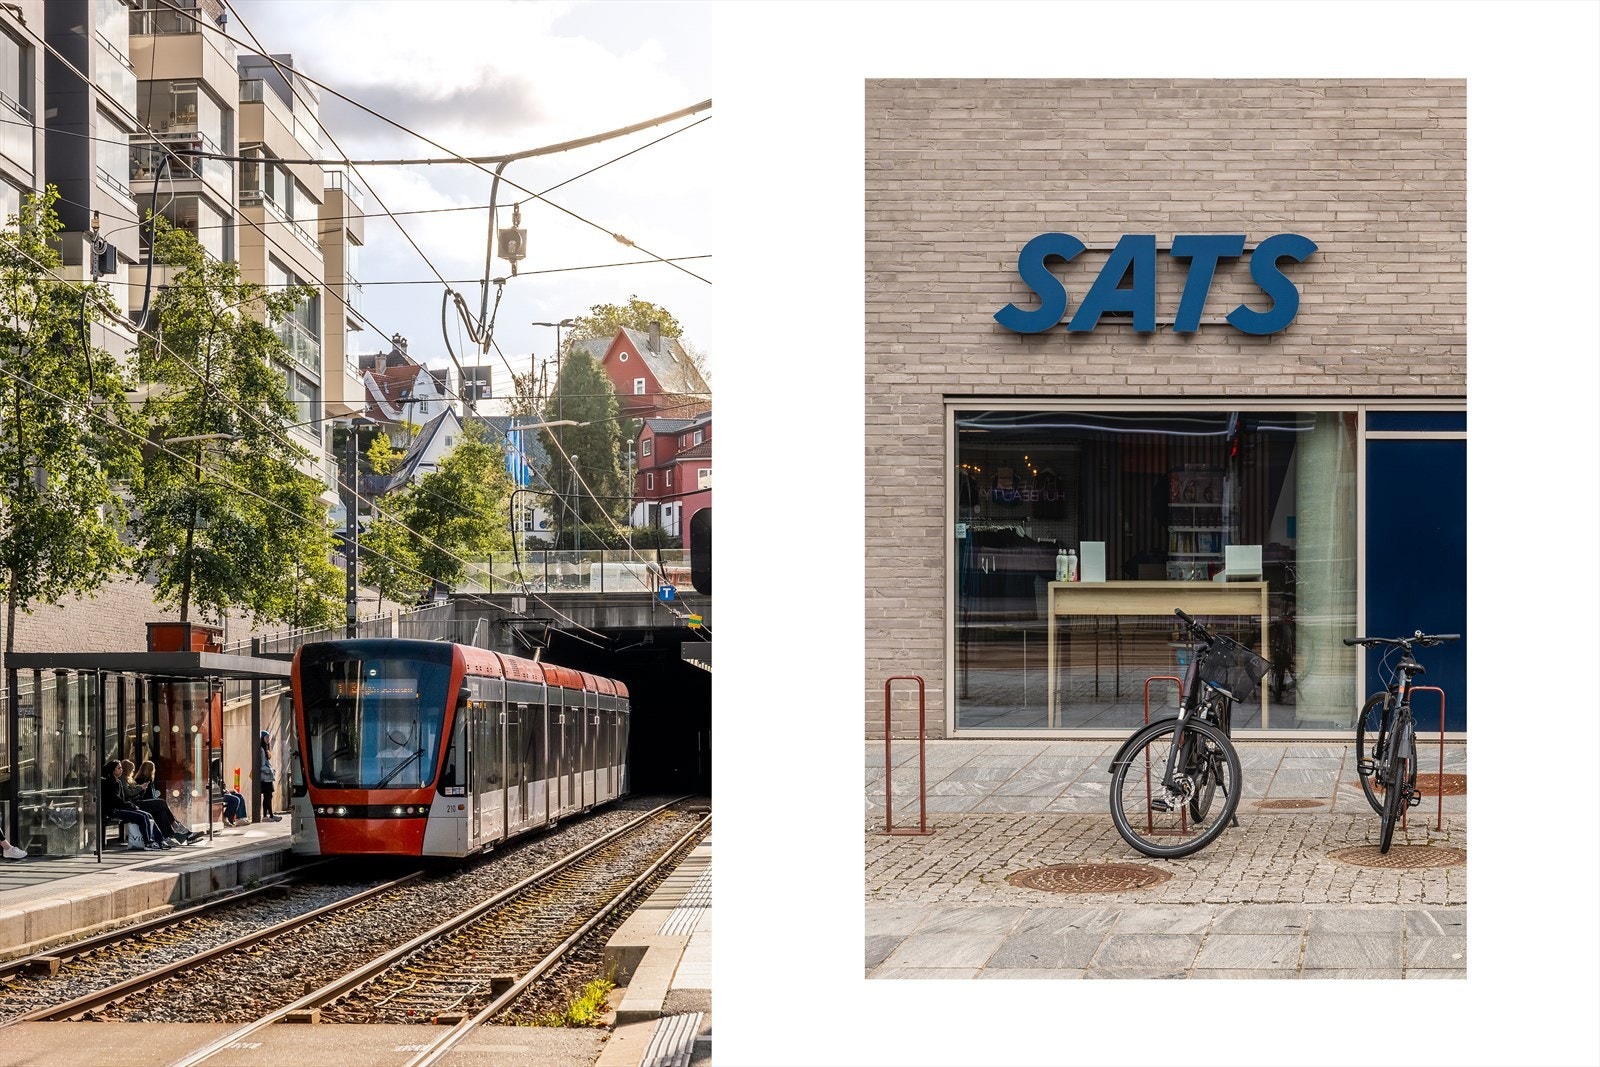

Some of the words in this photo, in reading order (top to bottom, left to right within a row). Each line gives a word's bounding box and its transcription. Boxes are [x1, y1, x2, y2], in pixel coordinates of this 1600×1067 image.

[993, 232, 1319, 335] SATS
[662, 588, 671, 598] T
[446, 804, 456, 813] 210
